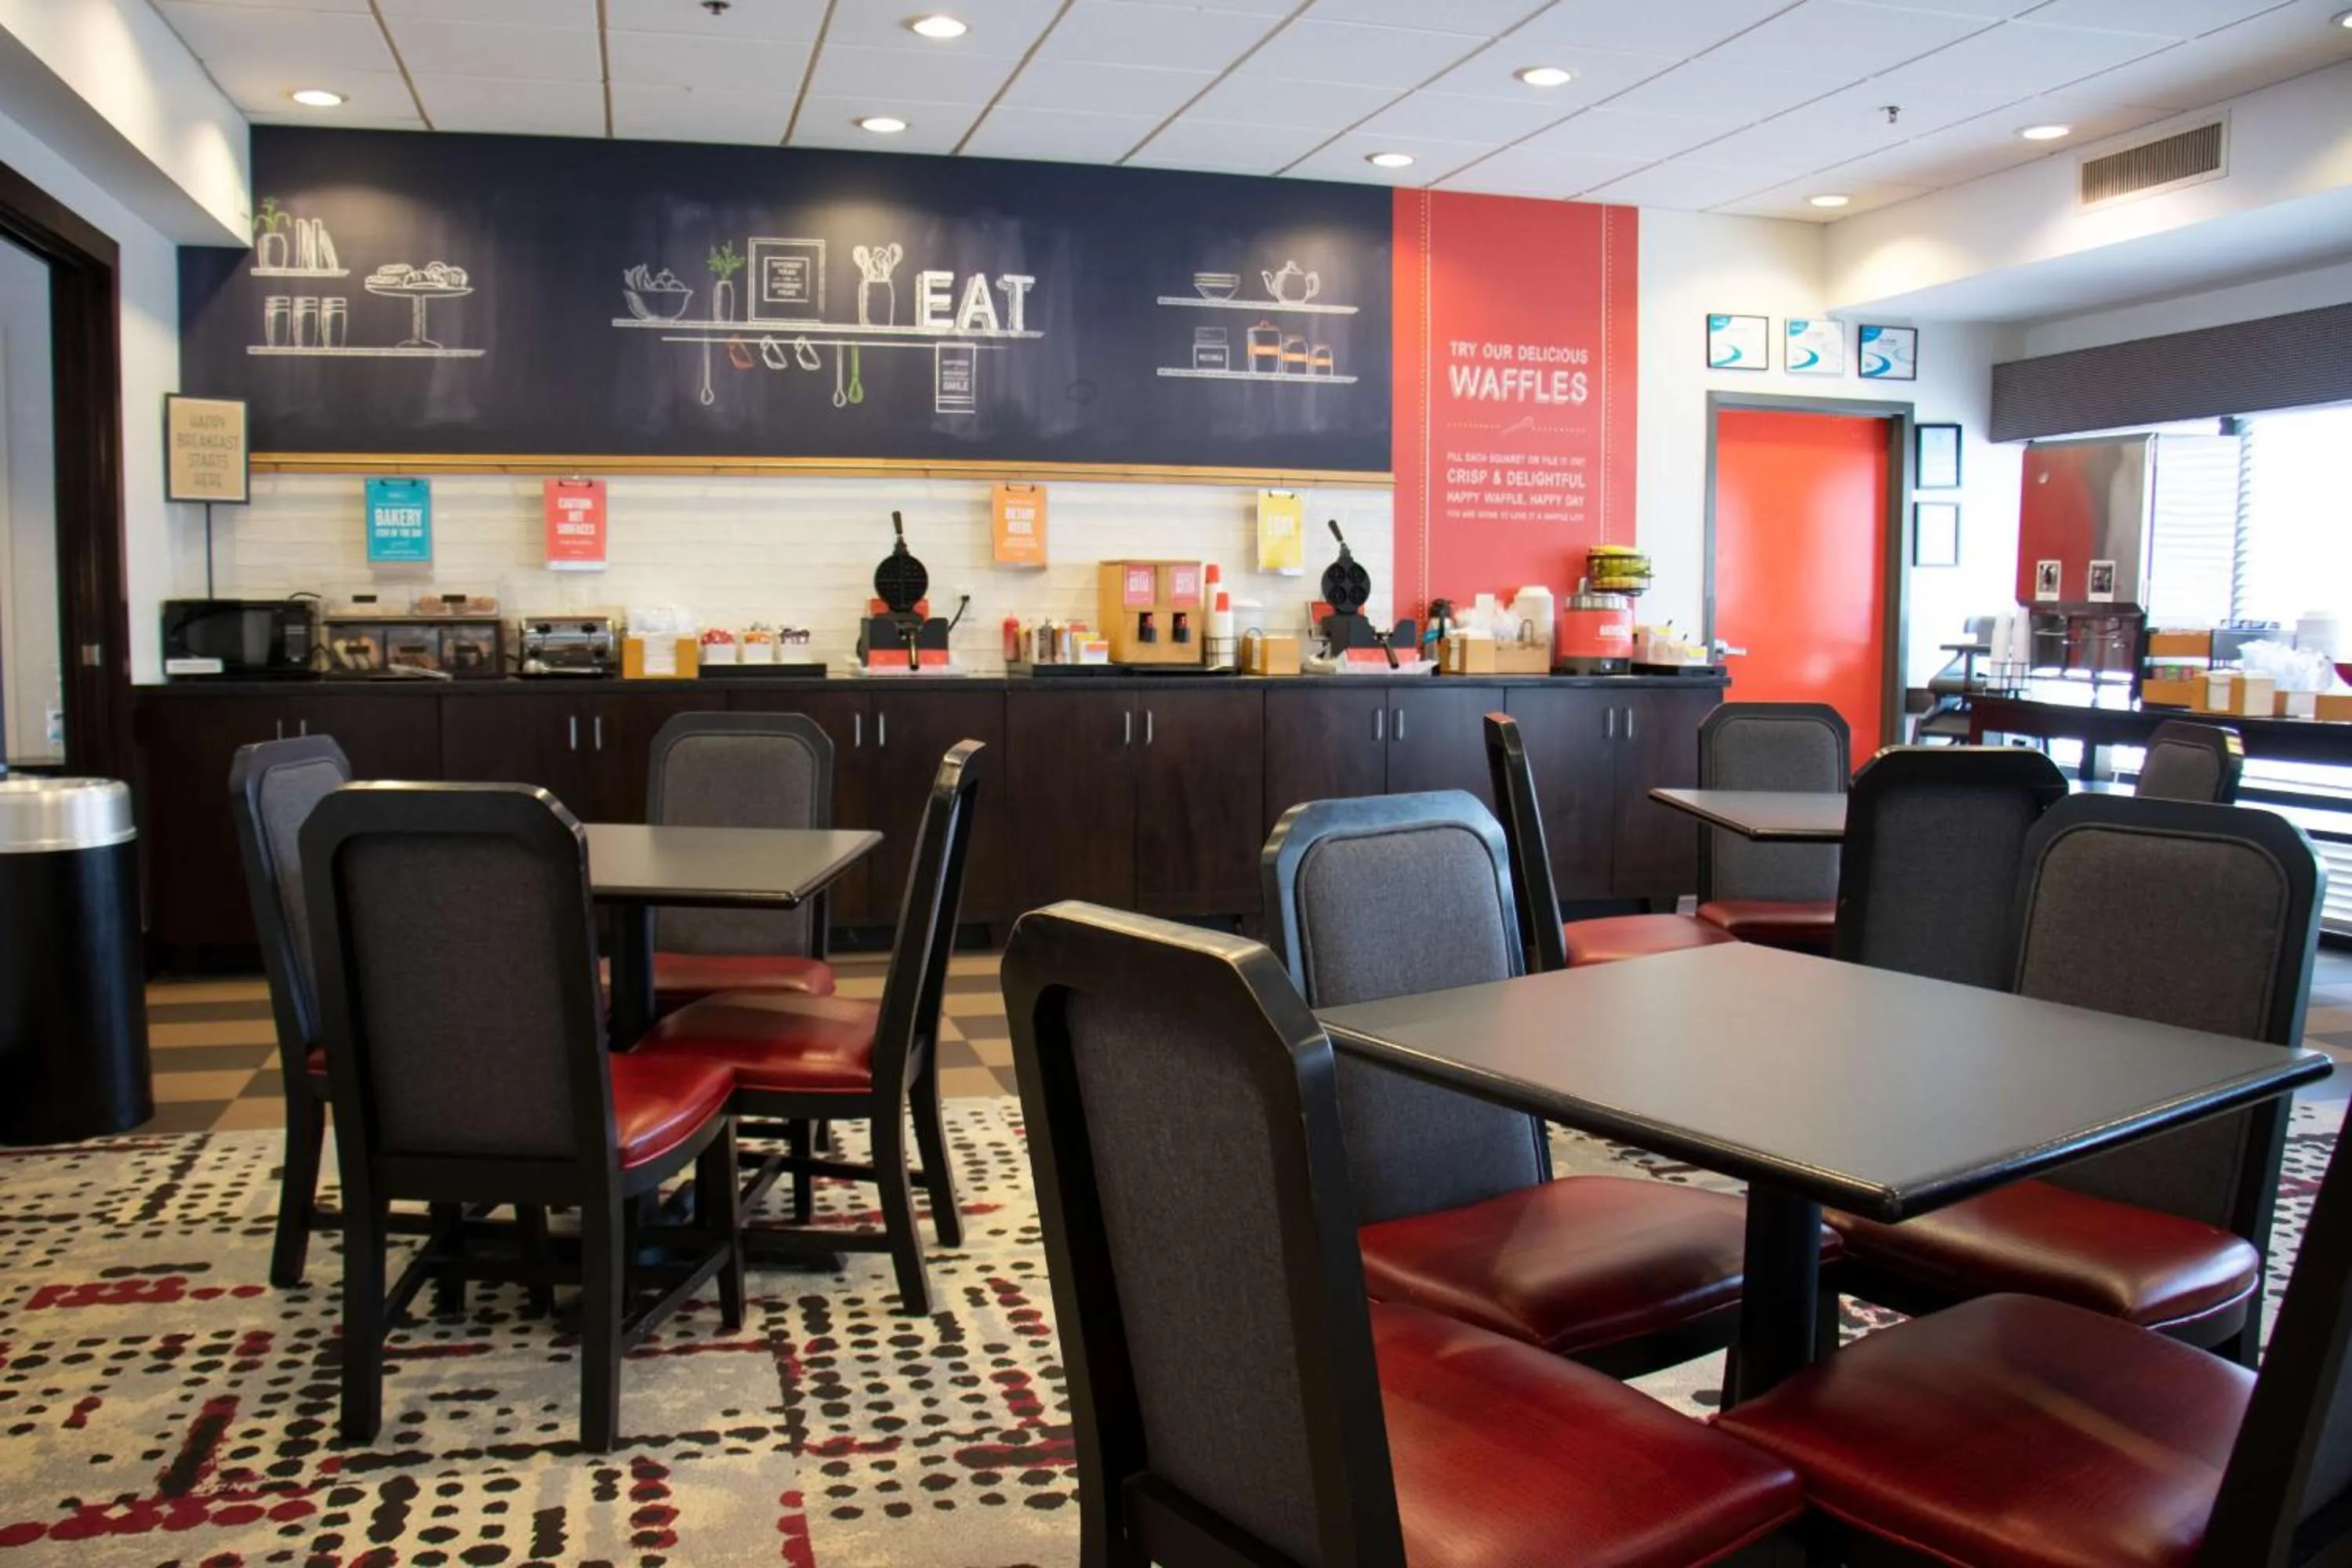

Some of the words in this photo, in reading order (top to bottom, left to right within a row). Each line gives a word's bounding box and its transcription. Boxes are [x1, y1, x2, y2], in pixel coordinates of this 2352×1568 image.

[914, 270, 1036, 332] EAT
[1450, 341, 1477, 358] TRY
[1483, 343, 1512, 360] OUR
[1517, 345, 1588, 365] DELICIOUS
[1449, 365, 1588, 404] WAFFLES
[1446, 452, 1463, 463] FILL
[1465, 452, 1487, 463] EACH
[1446, 467, 1488, 485] CRISP
[1493, 469, 1501, 485] &
[1507, 470, 1586, 488] DELIGHTFUL
[1446, 490, 1480, 503] HAPPY
[1530, 493, 1563, 506] HAPPY
[1564, 494, 1585, 507] DAY
[374, 507, 423, 527] BAKERY
